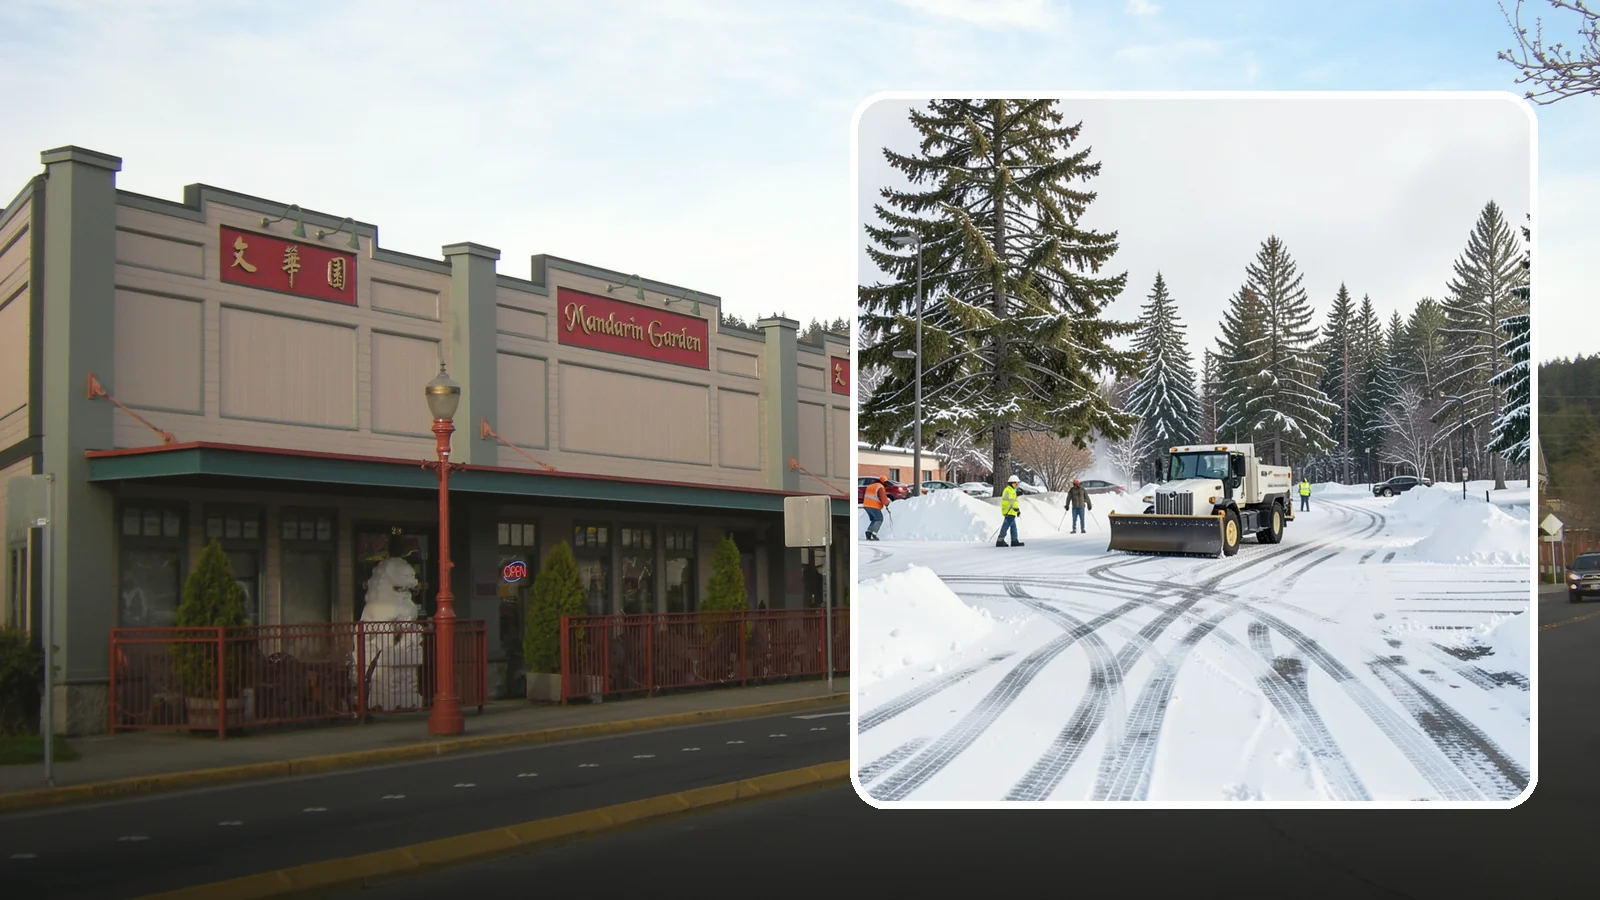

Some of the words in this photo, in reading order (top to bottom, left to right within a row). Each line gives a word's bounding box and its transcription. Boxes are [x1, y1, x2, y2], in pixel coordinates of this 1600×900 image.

[230, 236, 347, 291] 文華園
[564, 302, 644, 341] Mandarin
[647, 320, 701, 352] Garden
[503, 565, 527, 578] OPEN
